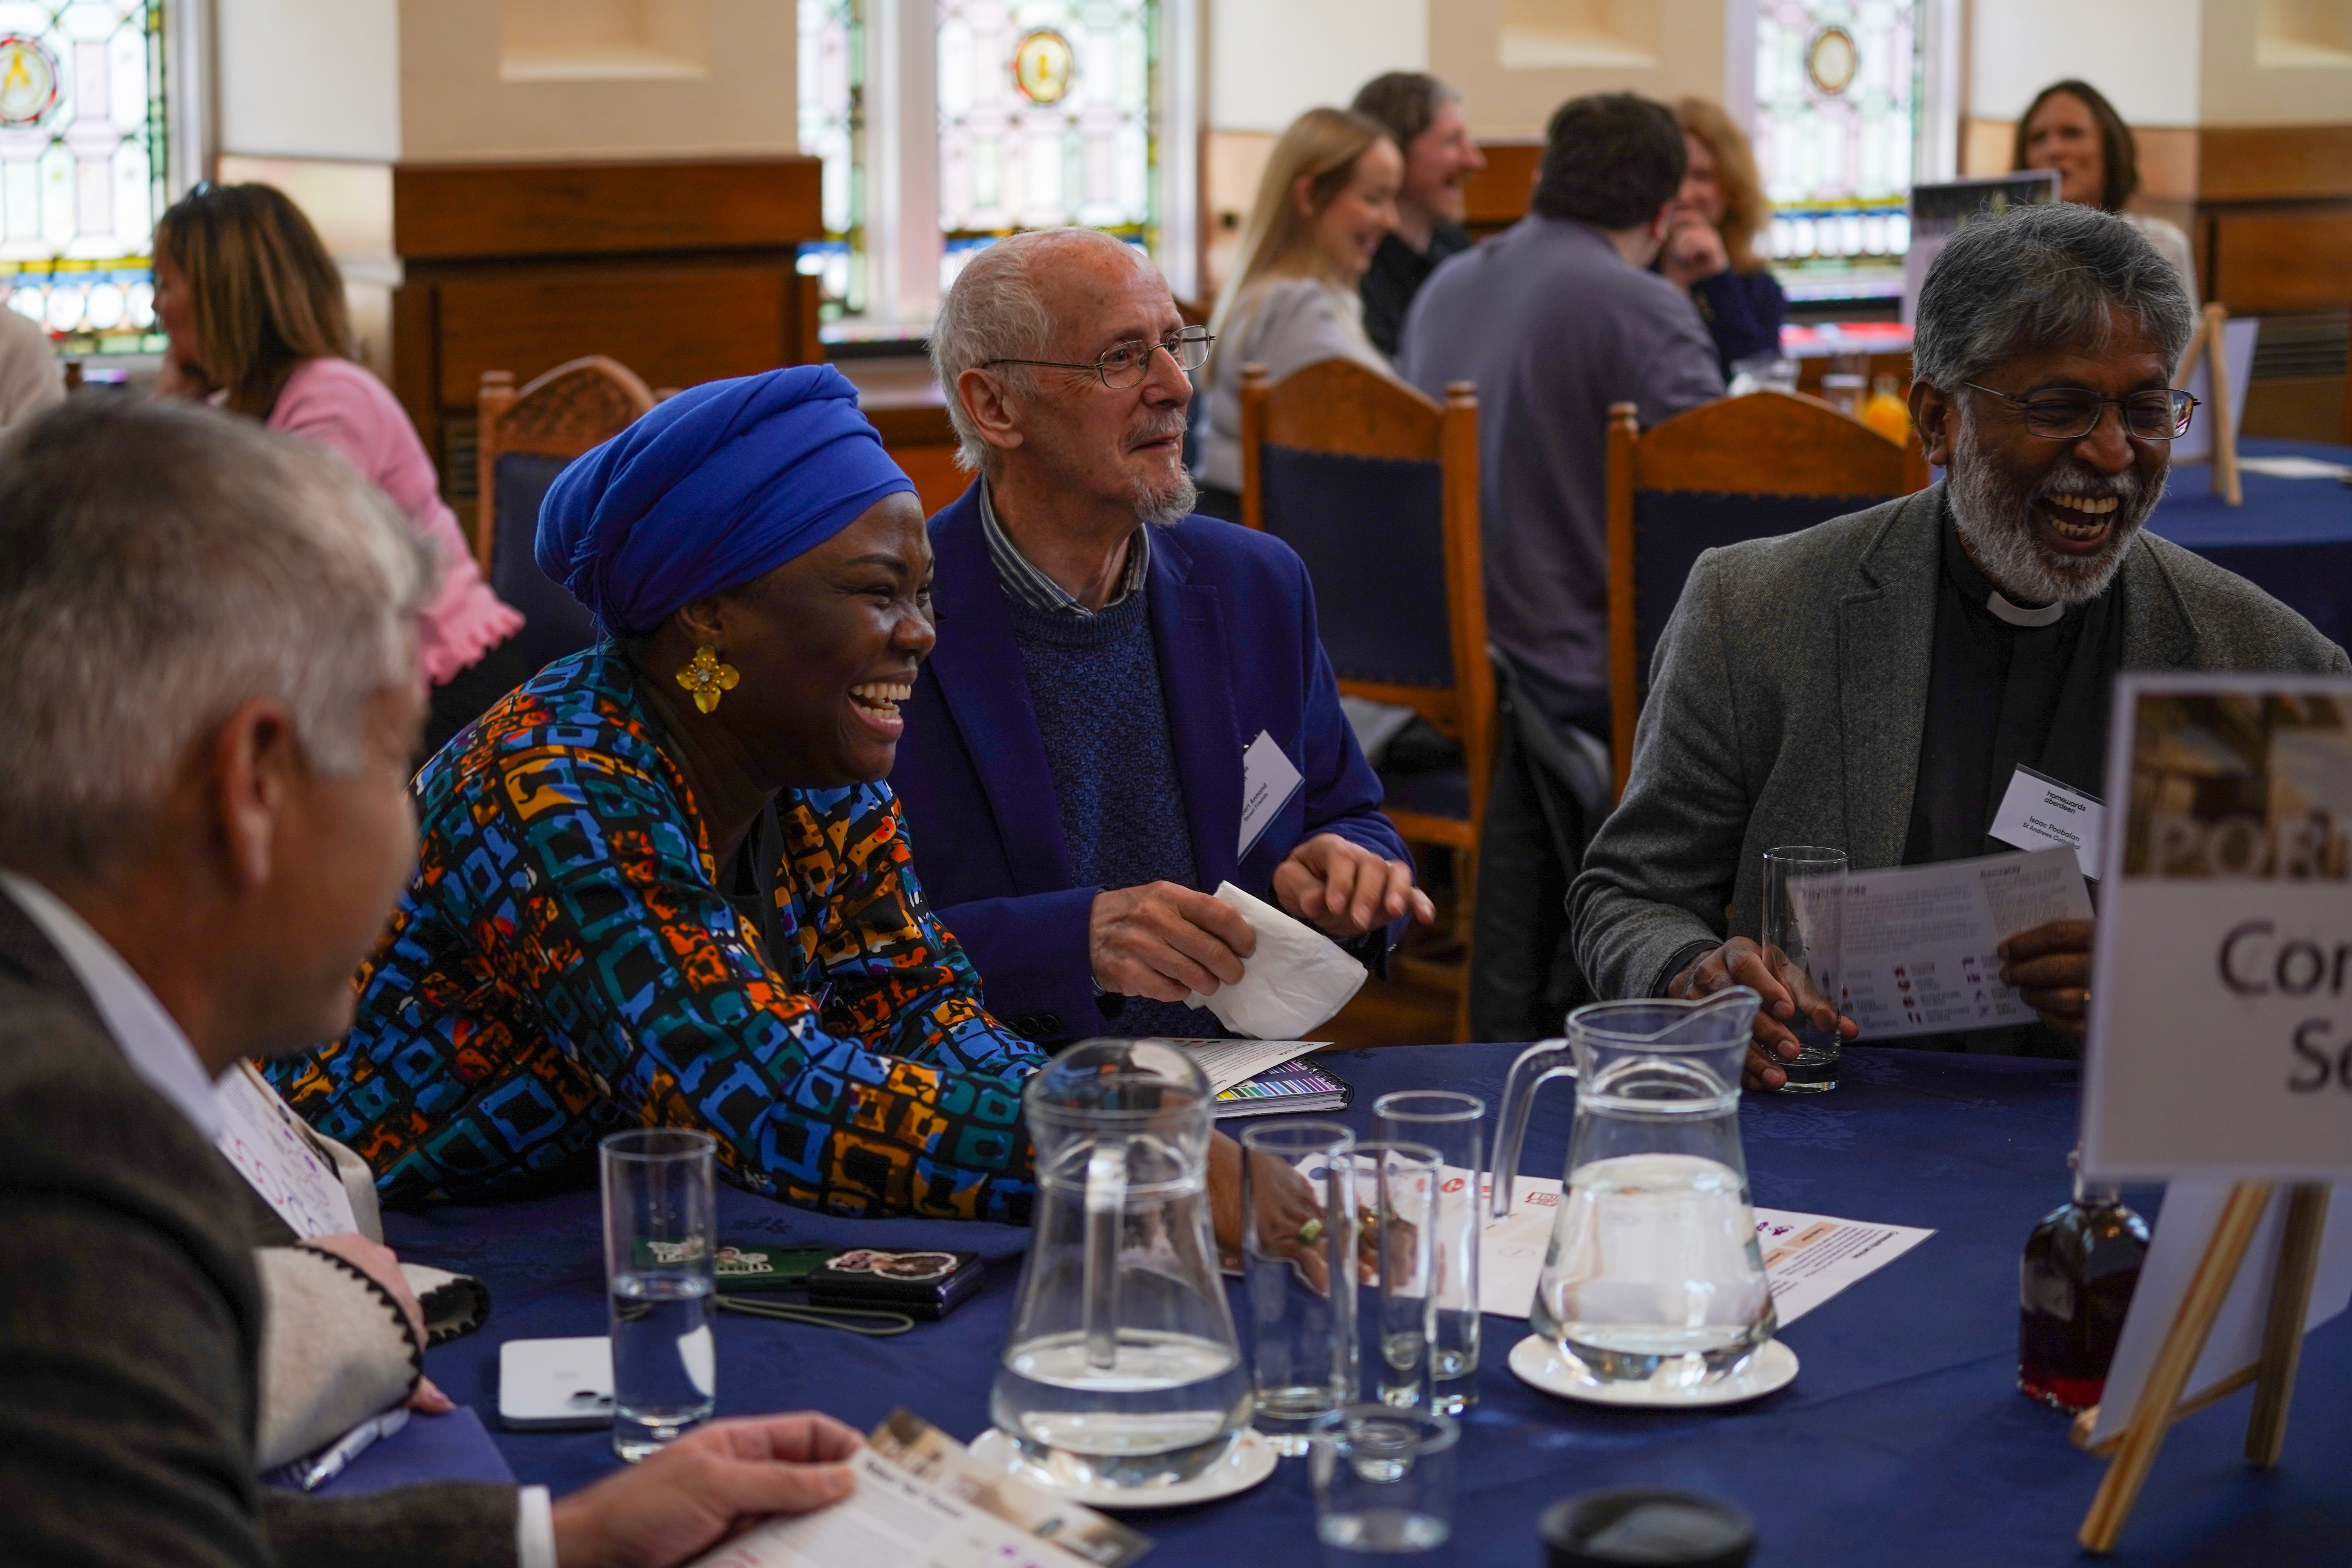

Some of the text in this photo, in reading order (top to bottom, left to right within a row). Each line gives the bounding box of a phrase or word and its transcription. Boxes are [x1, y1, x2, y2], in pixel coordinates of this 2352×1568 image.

[1250, 782, 1267, 804] Annand
[2047, 790, 2086, 811] homewards
[1244, 793, 1268, 822] Street Friends
[2044, 798, 2076, 814] aberdeen
[2029, 816, 2080, 842] Isaac Poobalan
[2029, 826, 2052, 838] Andrews
